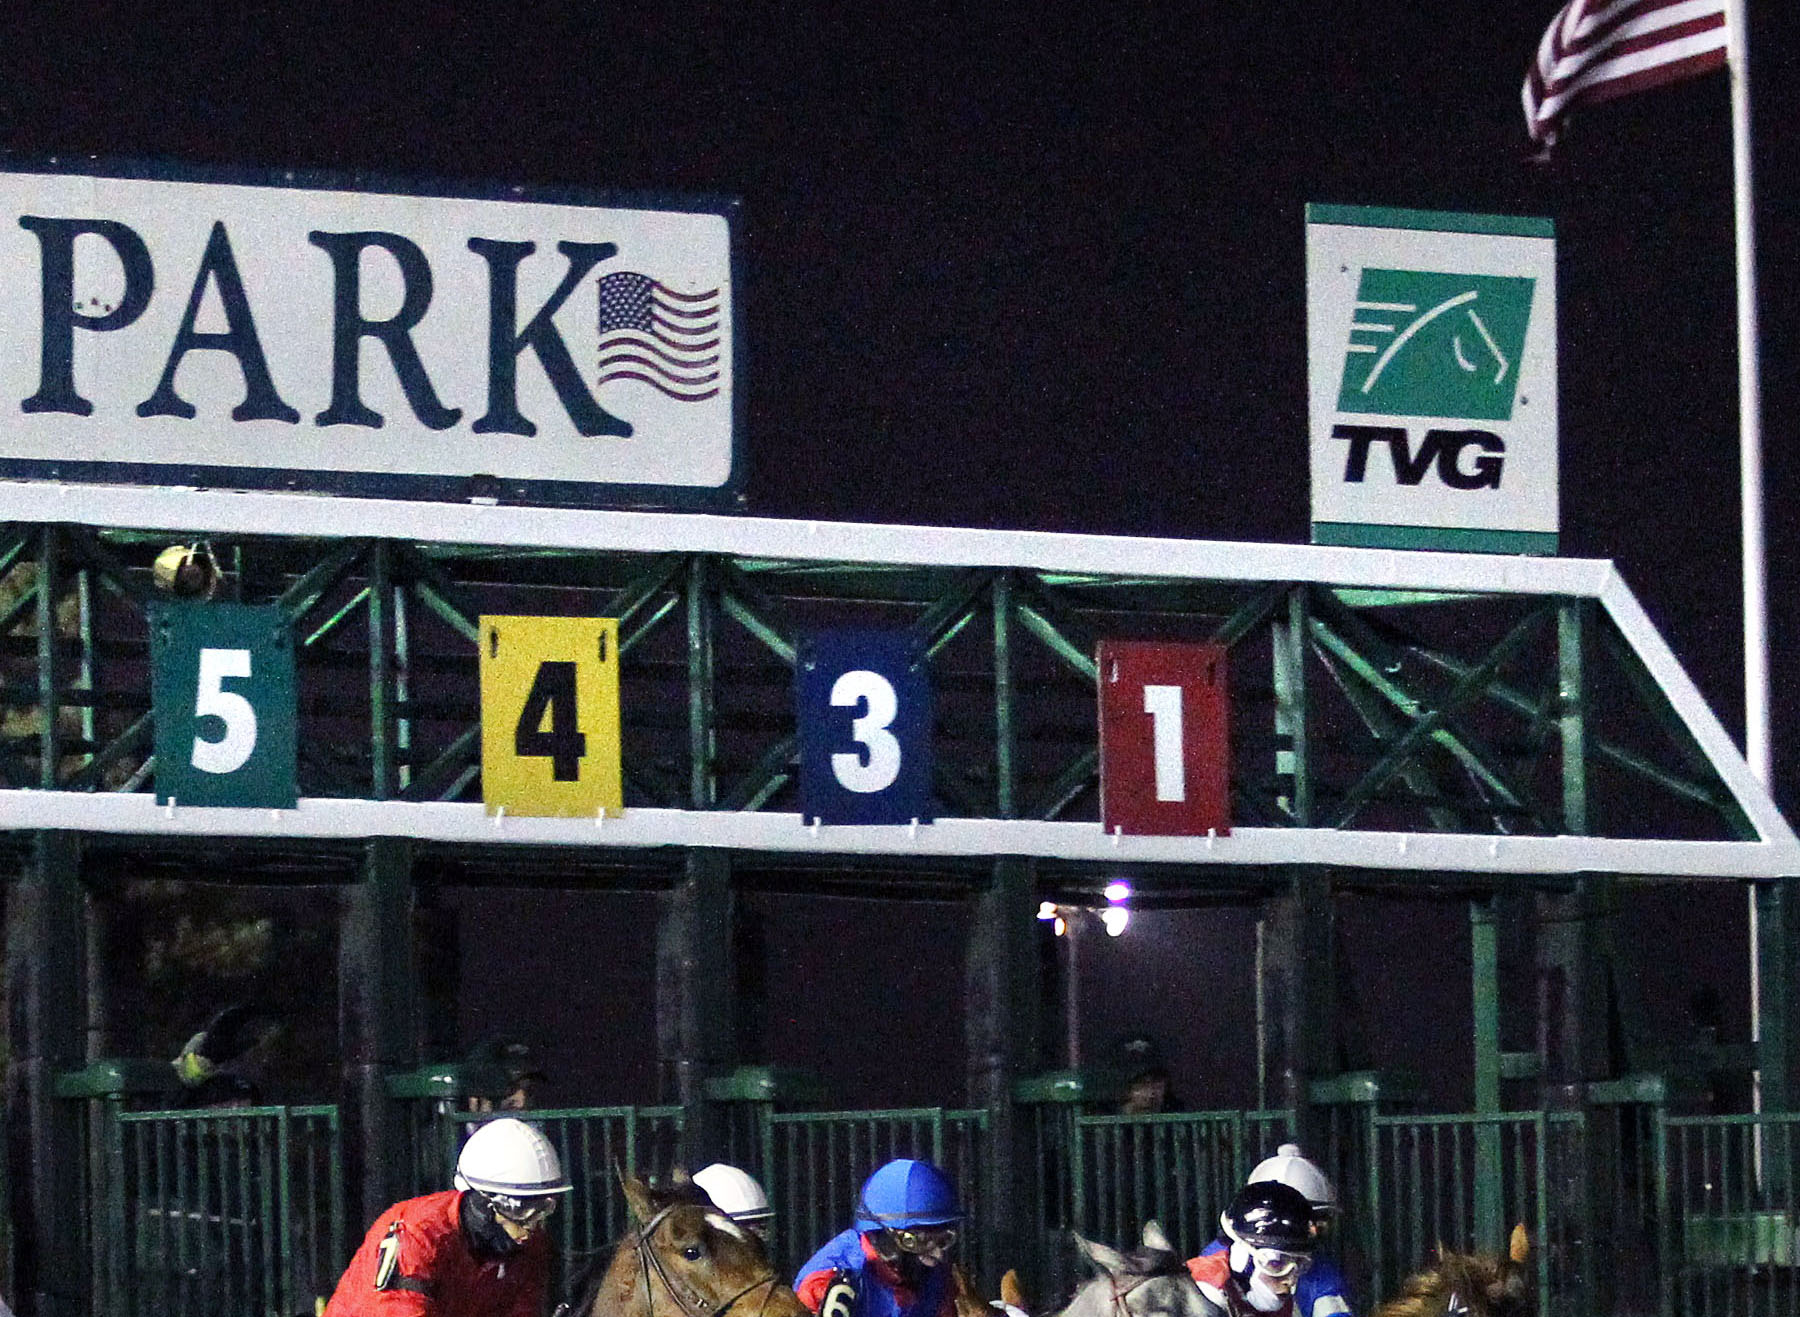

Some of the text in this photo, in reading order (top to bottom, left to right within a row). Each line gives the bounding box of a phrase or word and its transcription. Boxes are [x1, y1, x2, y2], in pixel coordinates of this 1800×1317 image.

[18, 215, 634, 439] PARK
[1331, 424, 1506, 490] TVG
[191, 647, 258, 774] 5
[515, 661, 587, 782] 4
[829, 669, 902, 794] 3
[1143, 684, 1185, 803] 1
